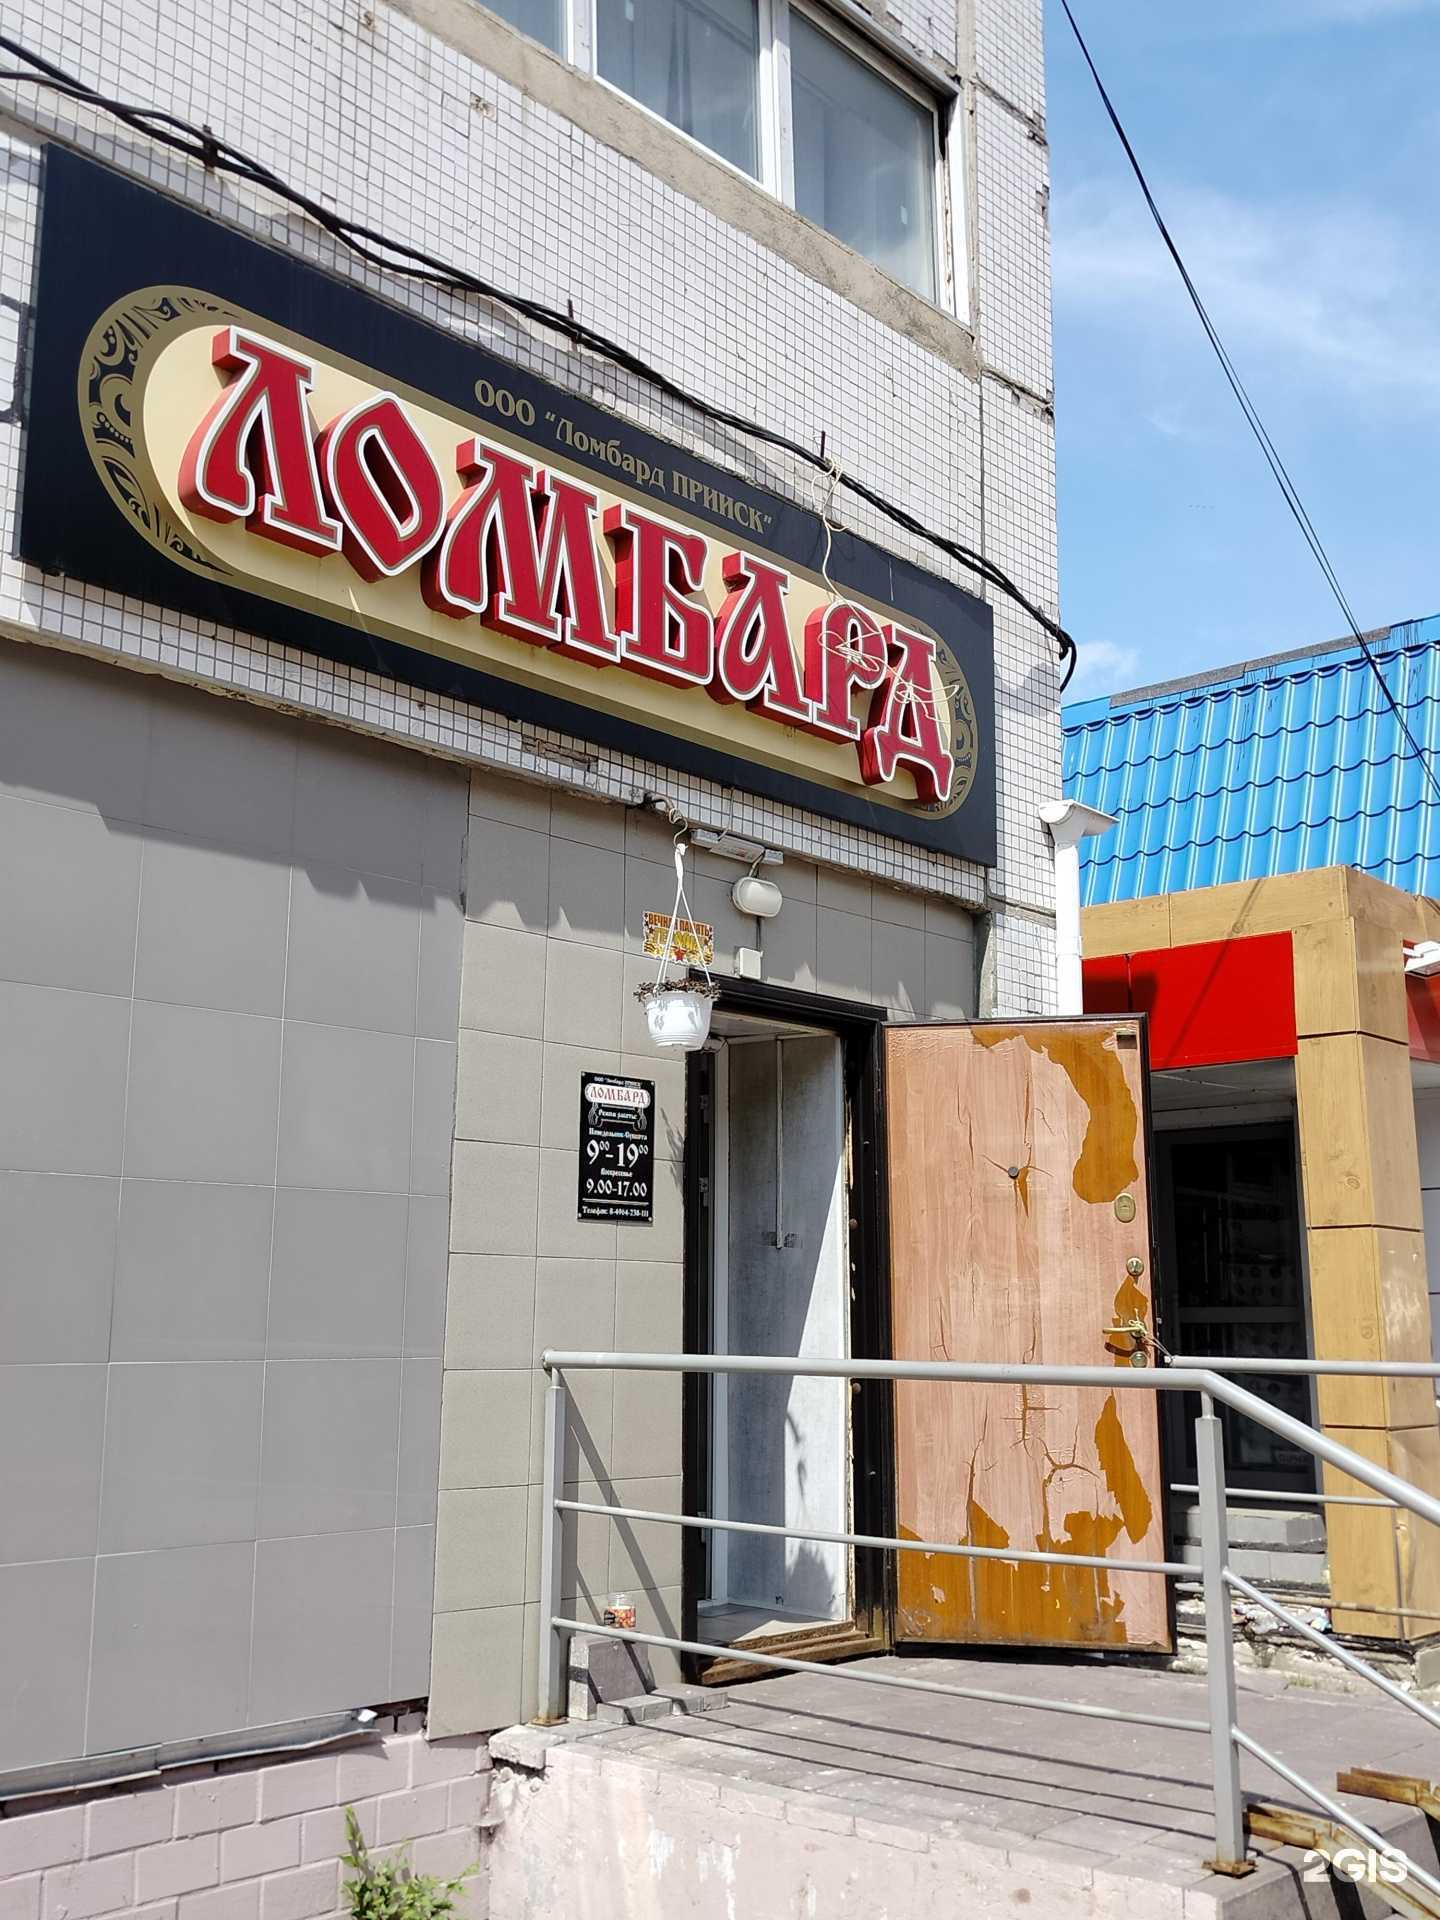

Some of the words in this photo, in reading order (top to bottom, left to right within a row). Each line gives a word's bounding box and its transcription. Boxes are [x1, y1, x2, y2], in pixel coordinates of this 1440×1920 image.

[474, 379, 536, 427] ООО
[671, 470, 773, 535] ПРИИСК"
[182, 325, 954, 802] ЛОМБАРД
[590, 1086, 645, 1105] ЛОМБАРД
[586, 1178, 648, 1198] 9.00-17.00
